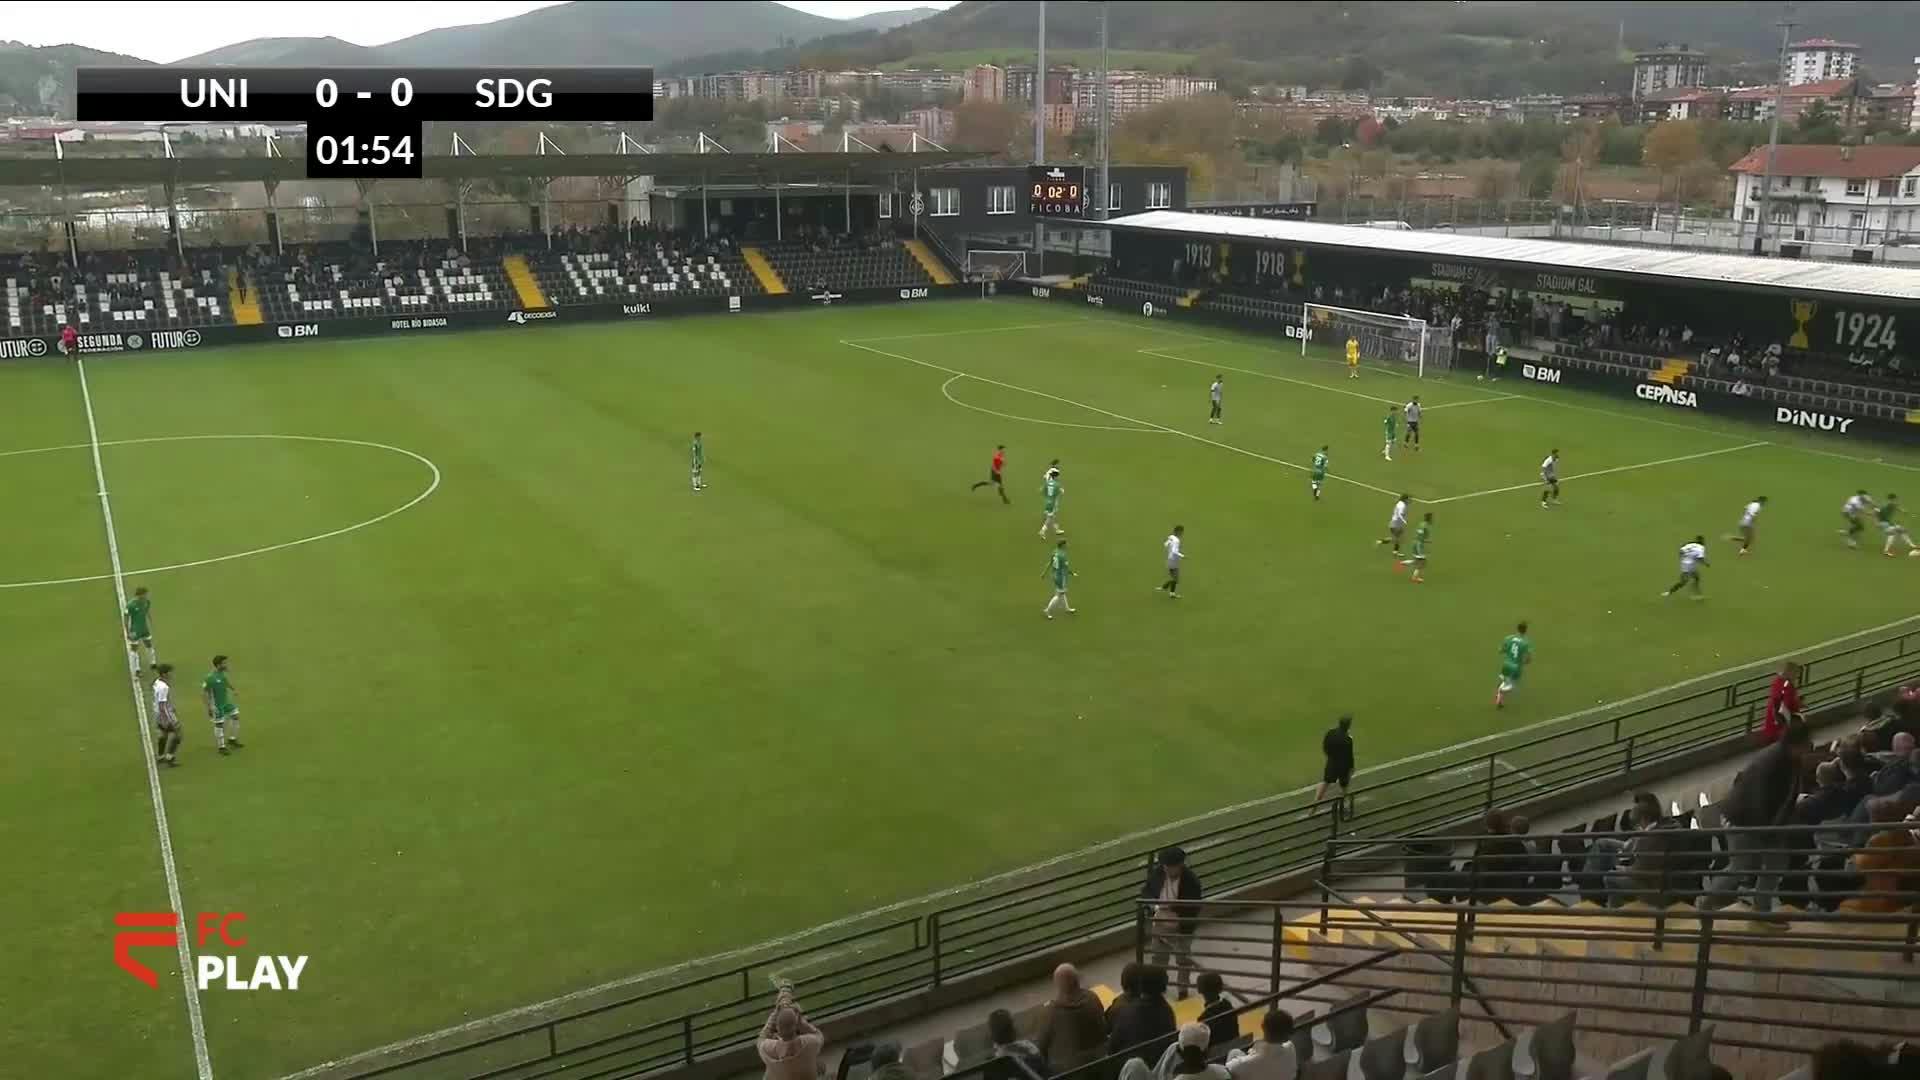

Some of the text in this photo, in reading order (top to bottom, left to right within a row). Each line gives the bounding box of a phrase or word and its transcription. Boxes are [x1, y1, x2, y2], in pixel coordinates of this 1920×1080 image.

[1031, 204, 1080, 213] FICOBA
[1186, 243, 1212, 268] 1913
[1256, 249, 1285, 276] 1918
[1536, 273, 1576, 290] STADIUM
[911, 288, 928, 298] BM
[294, 324, 319, 336] BM
[391, 319, 410, 329] HOTEL
[1834, 311, 1896, 350] 1924
[77, 333, 123, 349] SEGUNDA
[1295, 327, 1313, 341] BM
[1536, 367, 1561, 383] BM
